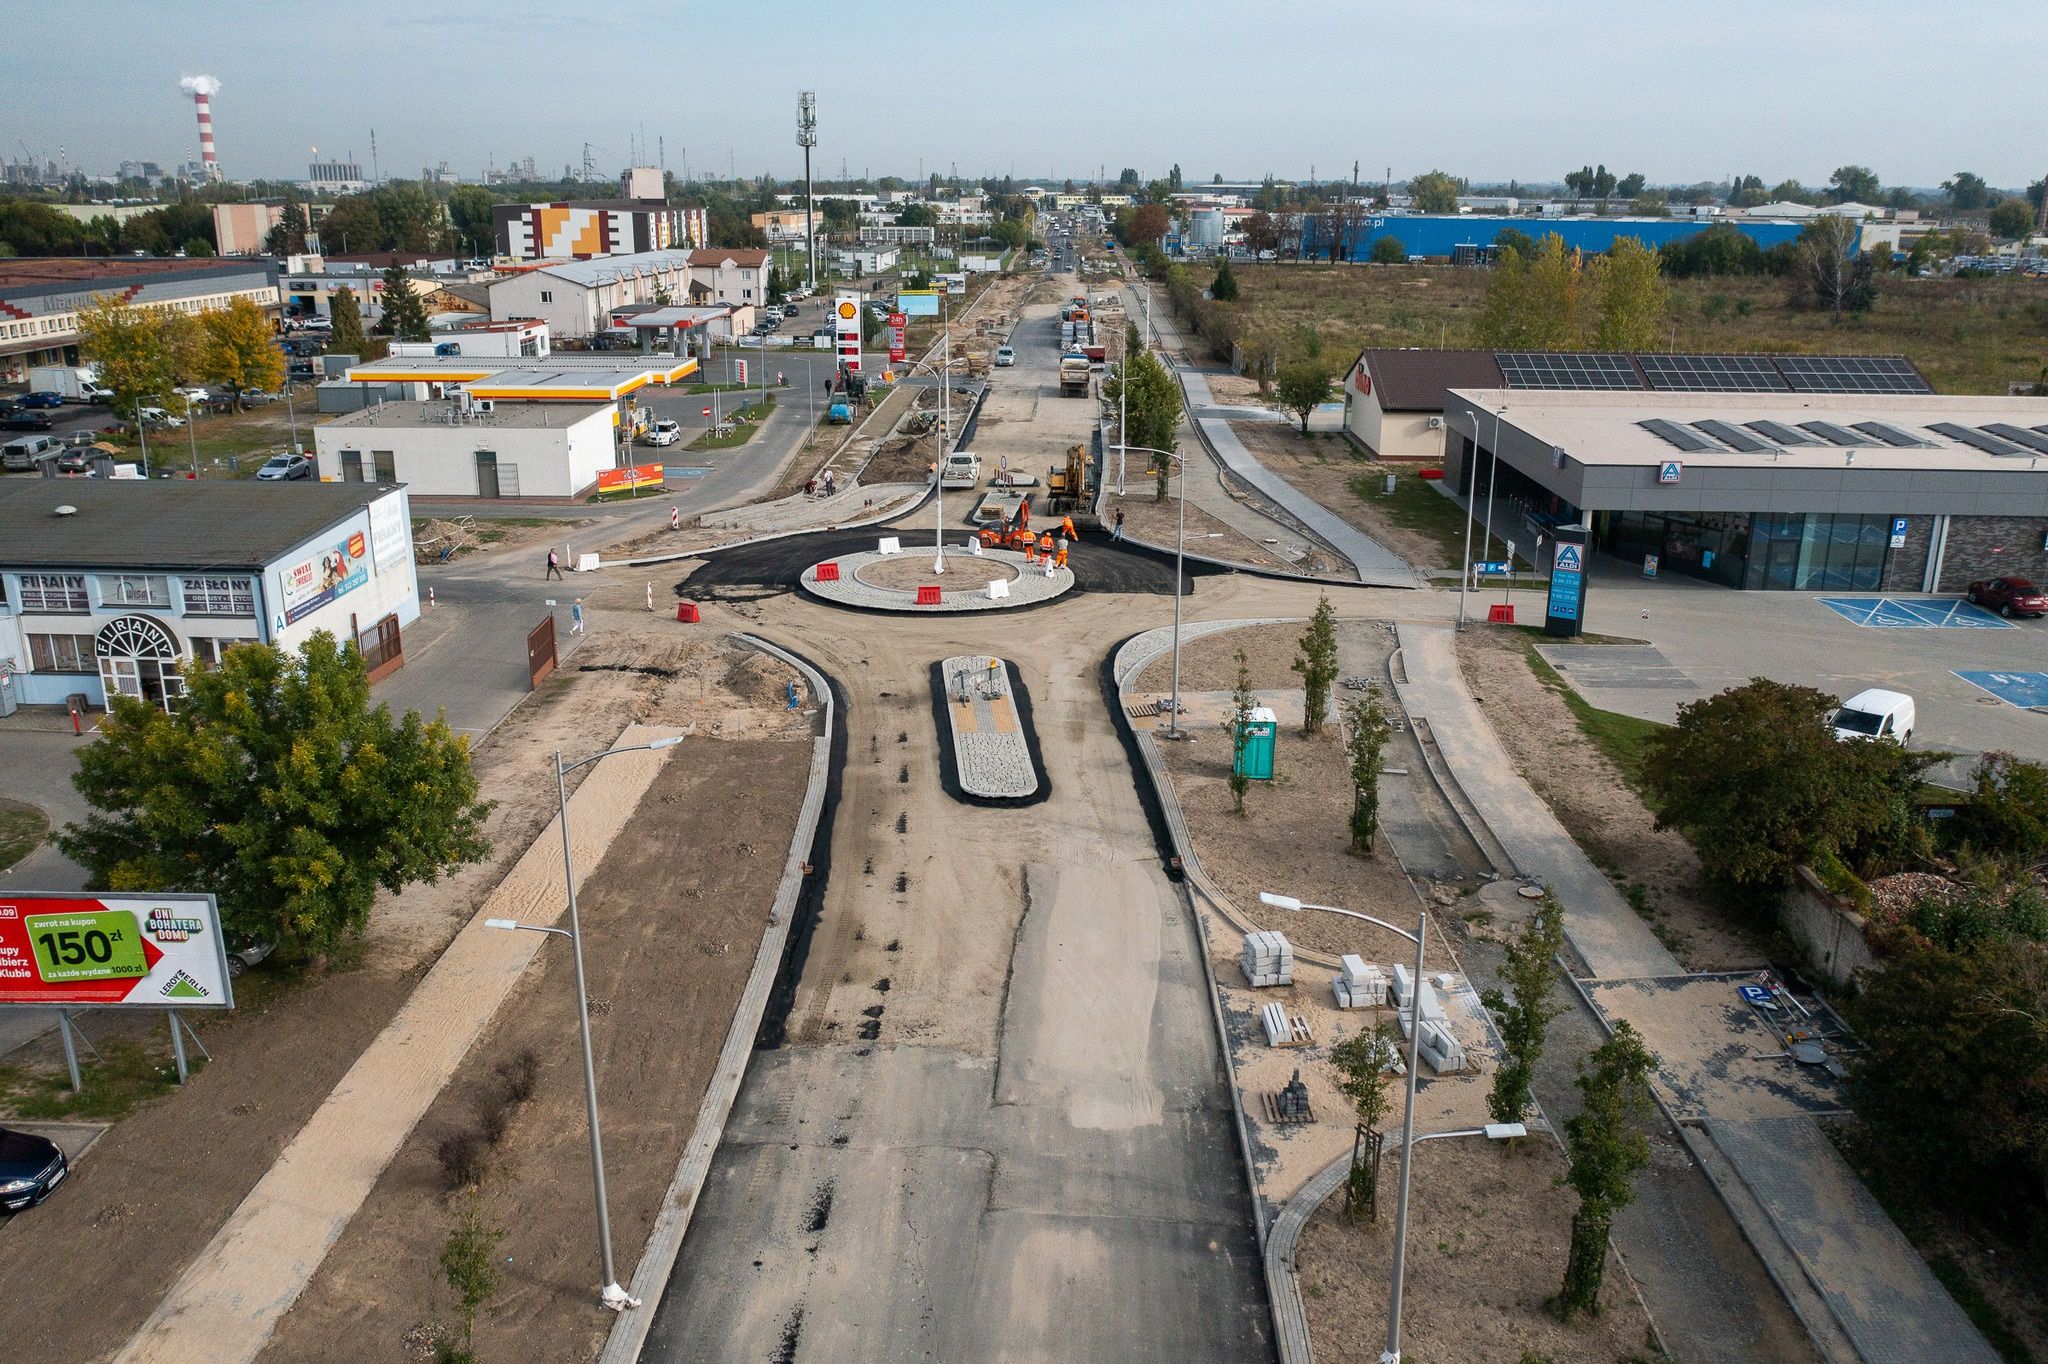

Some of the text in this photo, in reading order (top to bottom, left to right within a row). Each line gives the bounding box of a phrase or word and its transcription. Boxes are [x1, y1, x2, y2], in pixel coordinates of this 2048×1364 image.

[20, 576, 85, 591] FIRANY
[184, 579, 251, 591] ZASŁONY
[98, 619, 171, 653] FIRANY
[155, 908, 172, 919] DNI
[33, 920, 58, 928] zwrot
[71, 918, 97, 928] kupon
[149, 919, 202, 930] BOHATERA
[109, 929, 124, 942] zł
[159, 929, 188, 940] DOMU
[38, 930, 112, 966] 150
[58, 968, 80, 978] każde
[81, 967, 111, 979] wydane
[111, 965, 133, 974] 1000
[134, 963, 144, 972] zł
[159, 969, 210, 997] LEROY MERLIN
[1745, 987, 1763, 997] P
